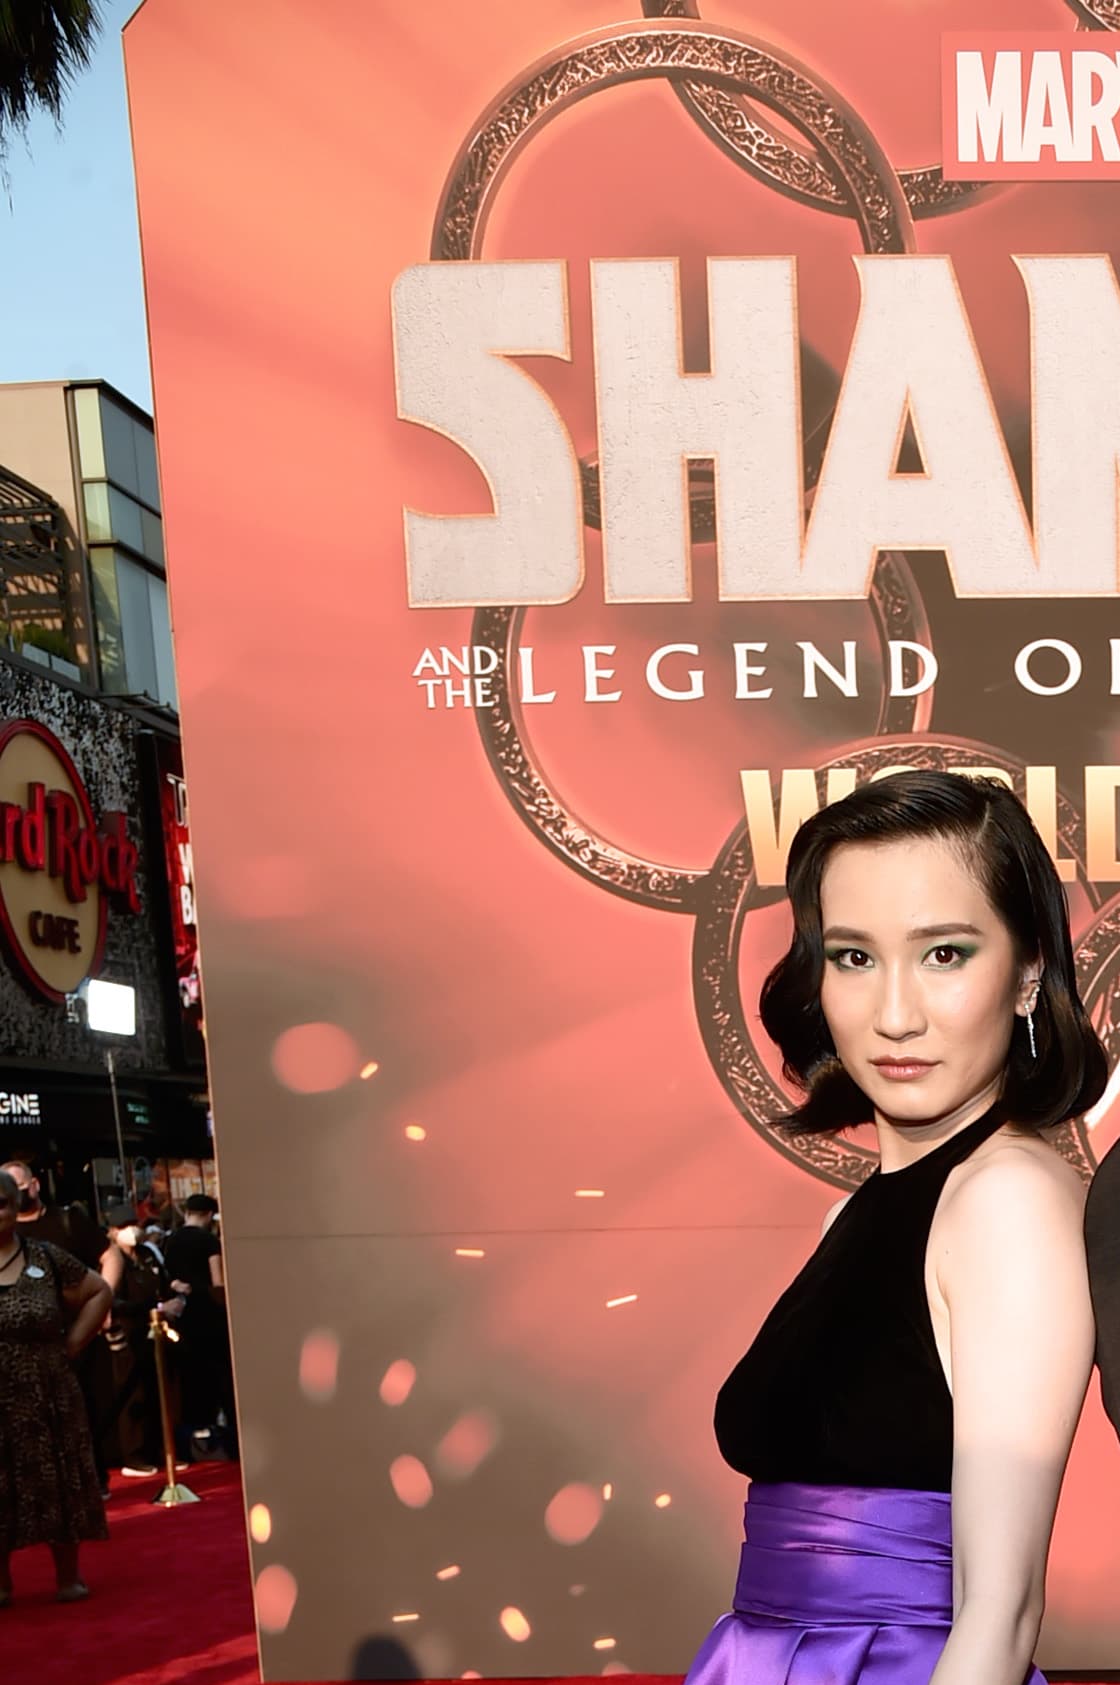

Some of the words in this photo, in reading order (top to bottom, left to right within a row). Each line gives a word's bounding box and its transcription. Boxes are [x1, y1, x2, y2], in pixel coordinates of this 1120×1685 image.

[412, 646, 499, 678] AND
[518, 640, 939, 704] LEGEND
[417, 678, 496, 708] THE
[0, 782, 46, 871] rd
[47, 789, 142, 911] Rock
[28, 910, 81, 954] CAFE
